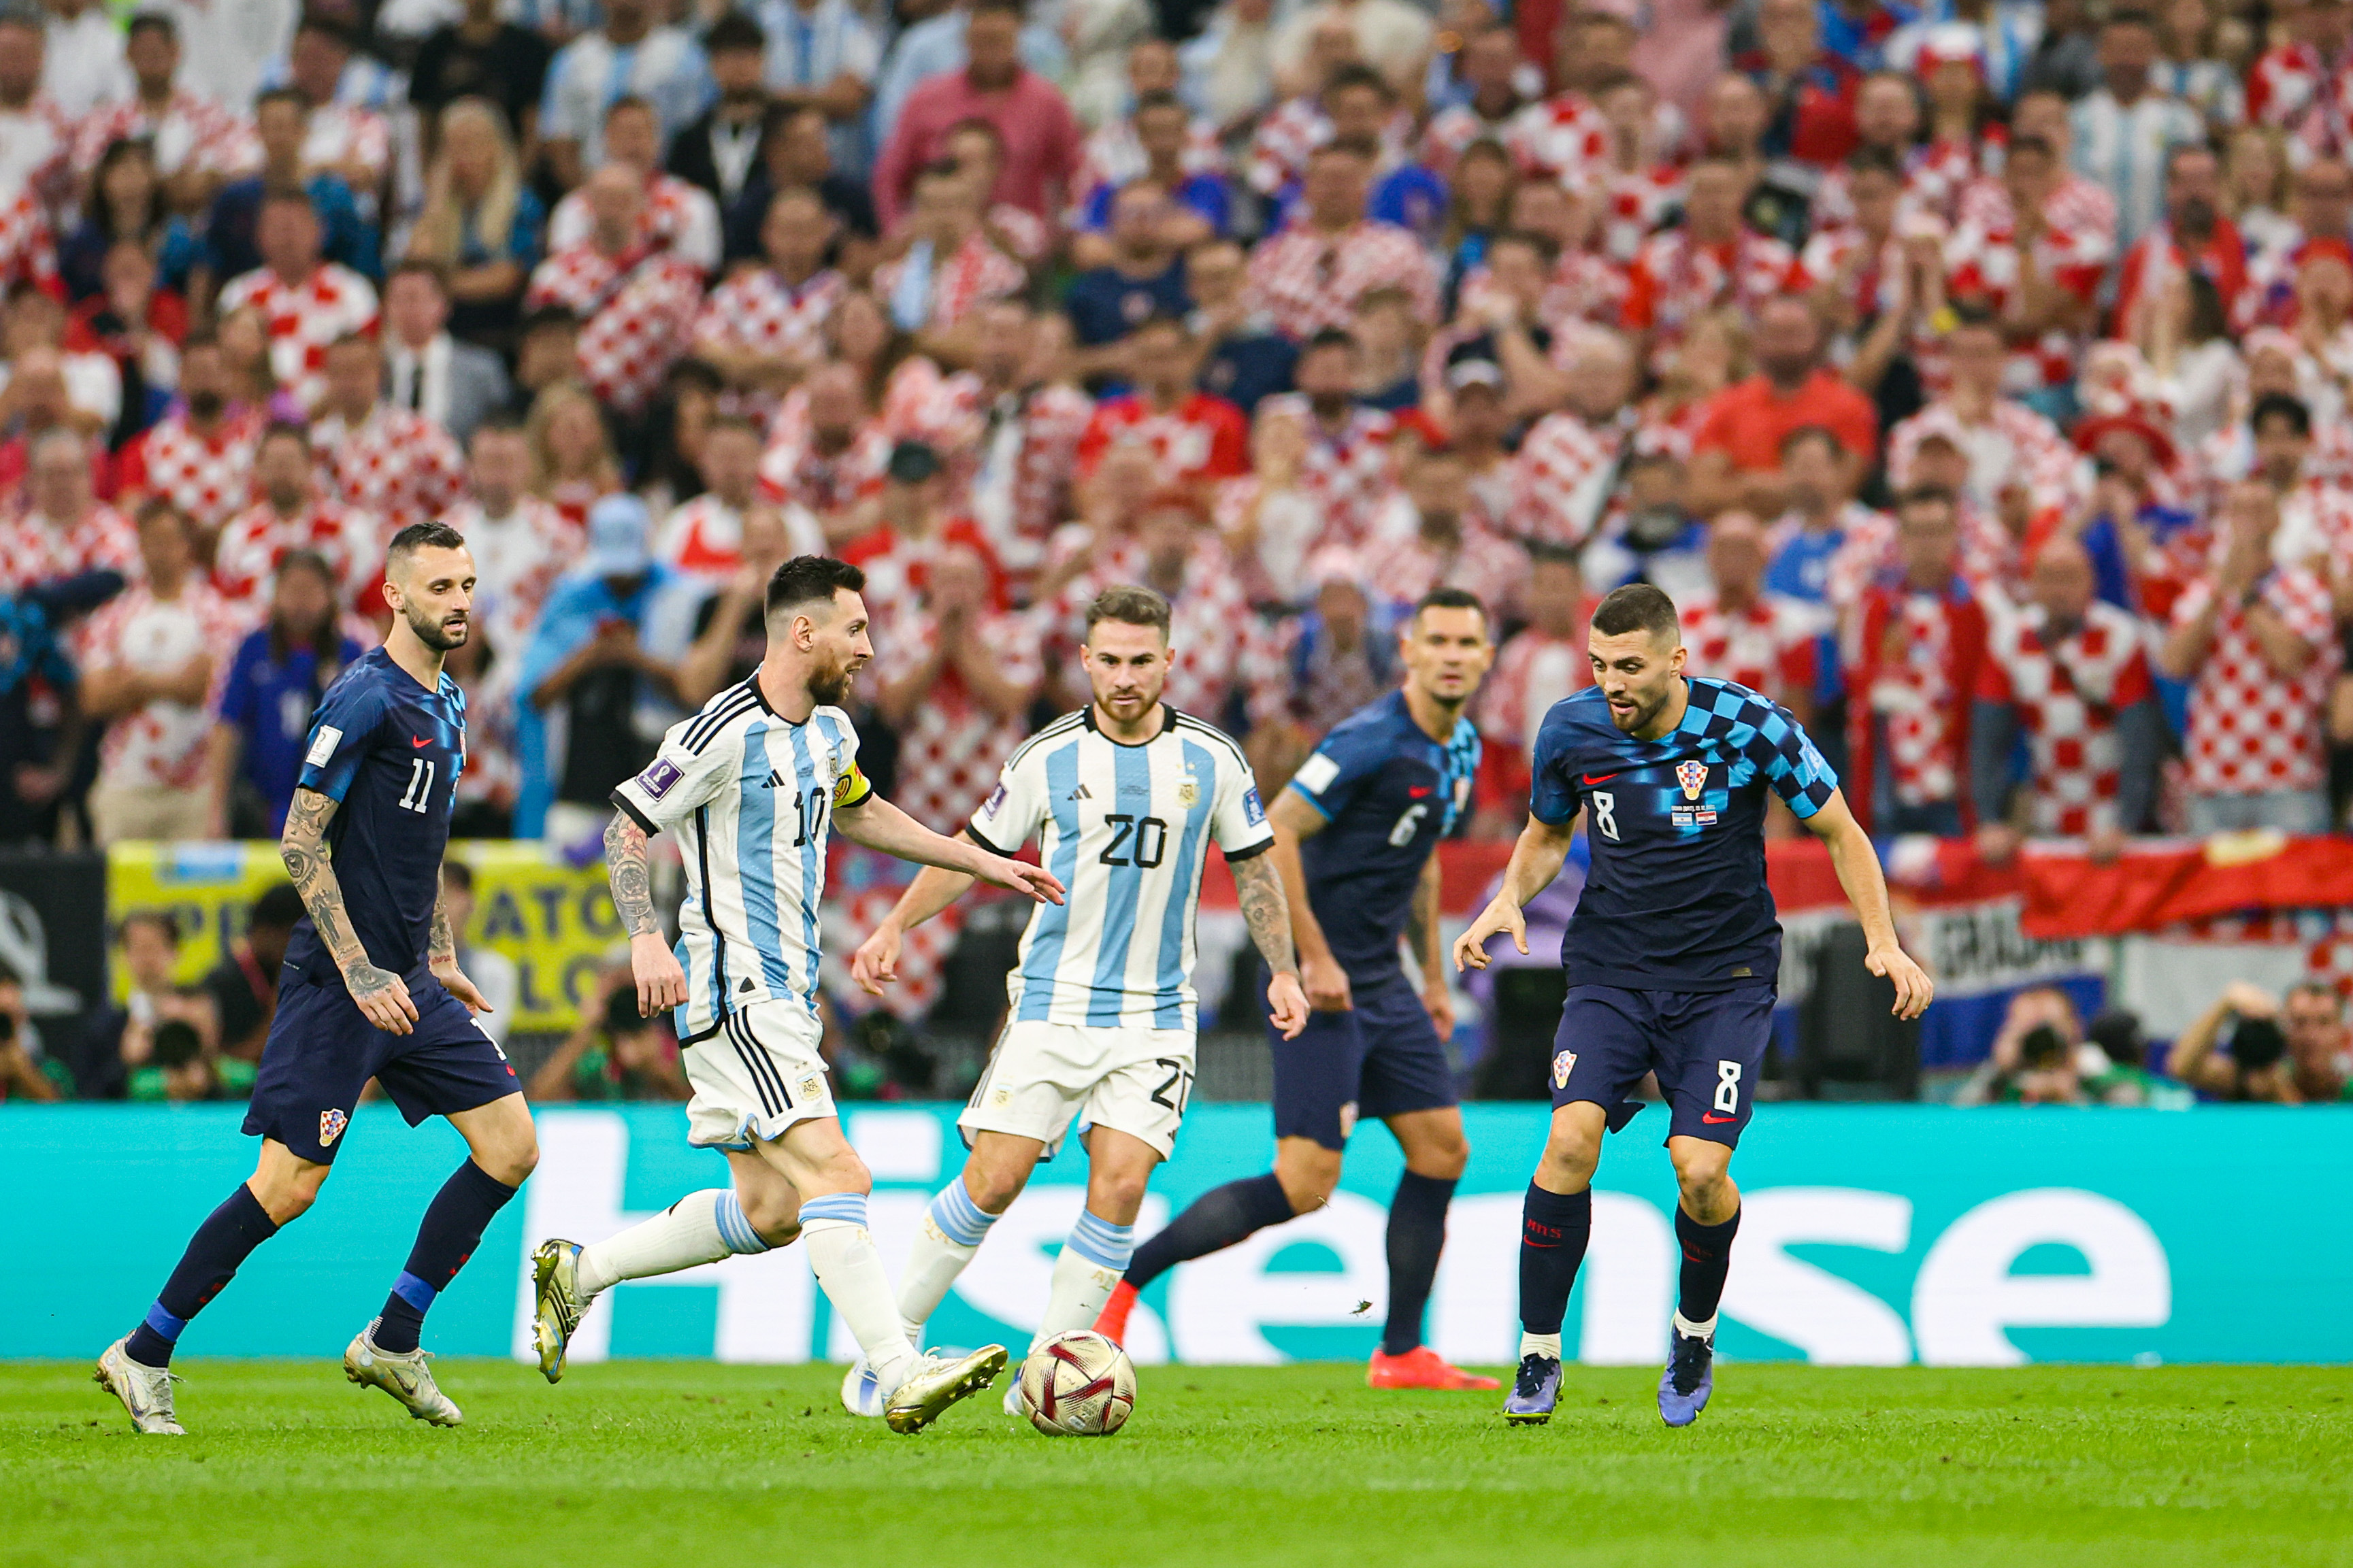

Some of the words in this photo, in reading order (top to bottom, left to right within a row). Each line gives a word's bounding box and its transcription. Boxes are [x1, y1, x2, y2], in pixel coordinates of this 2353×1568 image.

[399, 758, 435, 814] 11
[793, 787, 826, 847] 10
[1100, 814, 1167, 869] 20
[1388, 803, 1428, 847] 6
[1592, 790, 1620, 841] 8
[1713, 1059, 1742, 1115] 8
[507, 1110, 2172, 1366] Hisense
